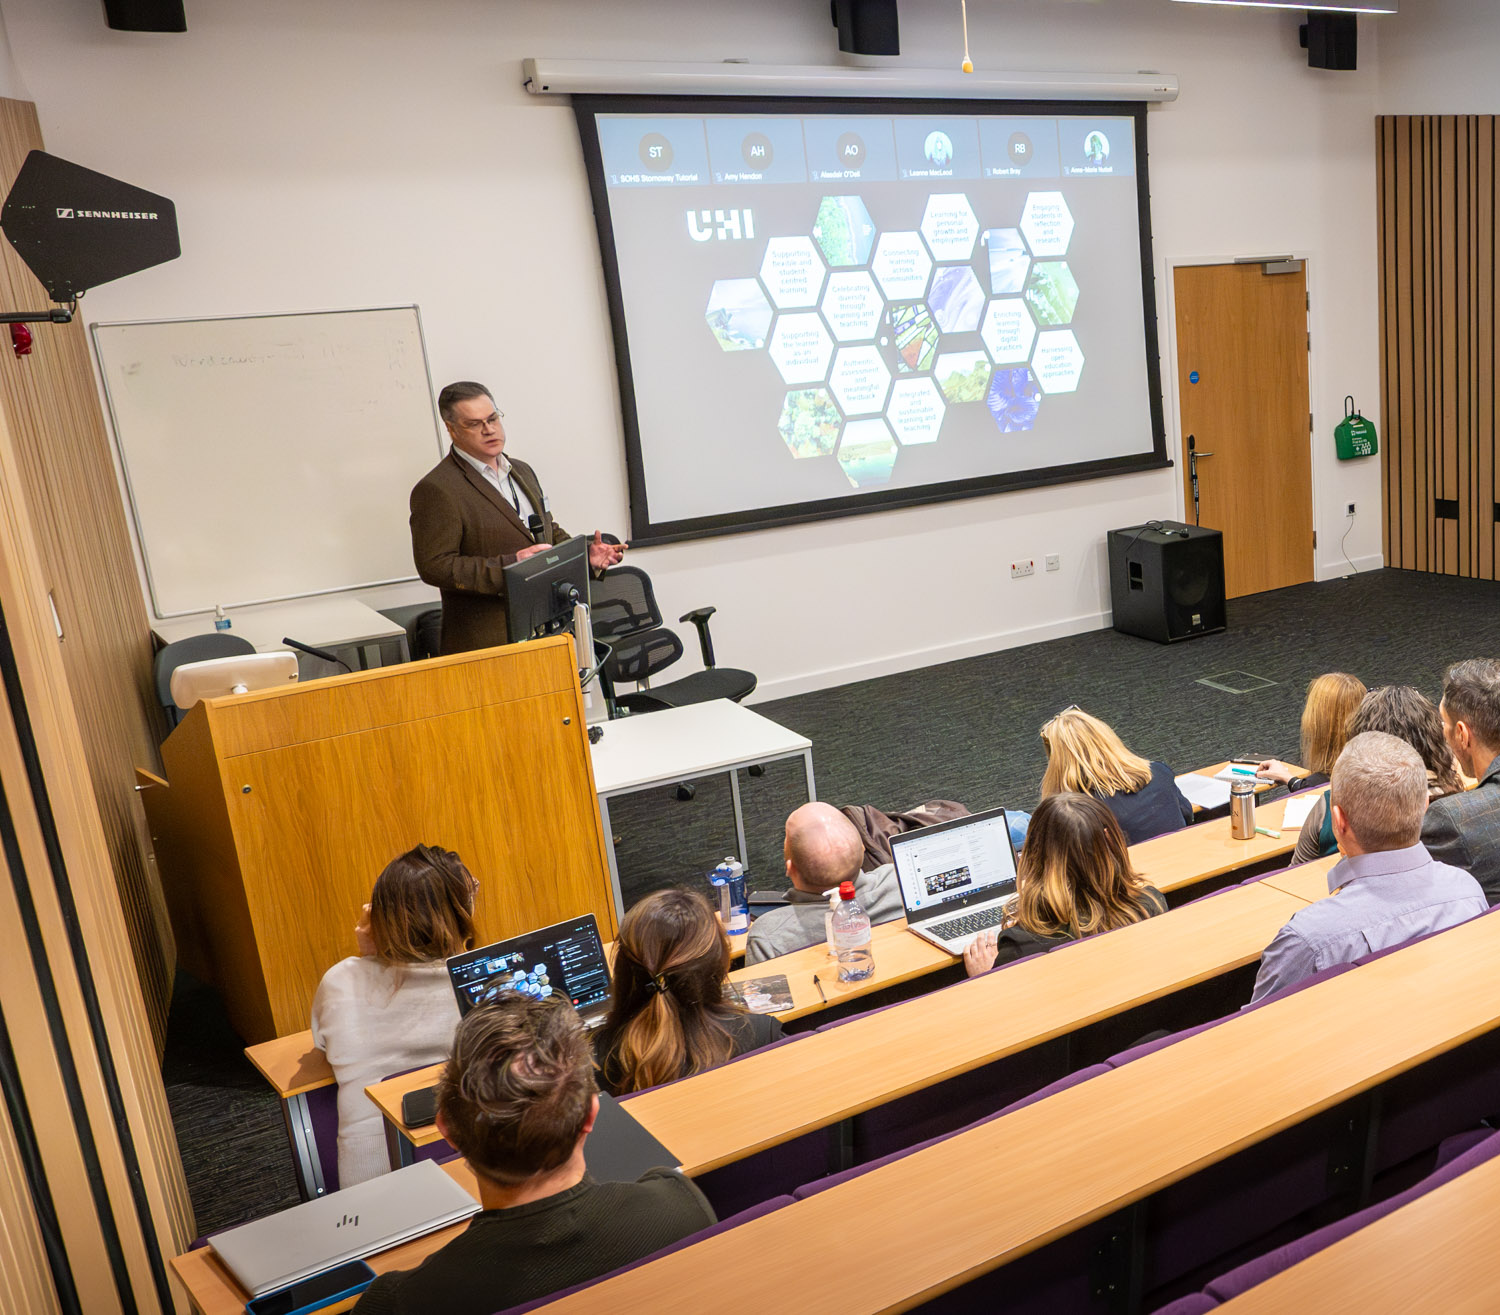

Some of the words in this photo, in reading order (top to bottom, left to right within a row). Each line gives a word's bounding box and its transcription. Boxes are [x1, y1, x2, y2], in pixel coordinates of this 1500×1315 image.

[649, 147, 662, 158] ST
[750, 147, 765, 157] AH
[844, 145, 858, 156] AO
[1014, 143, 1026, 154] RB
[77, 210, 158, 220] SENNHEISER
[686, 208, 755, 242] UHI
